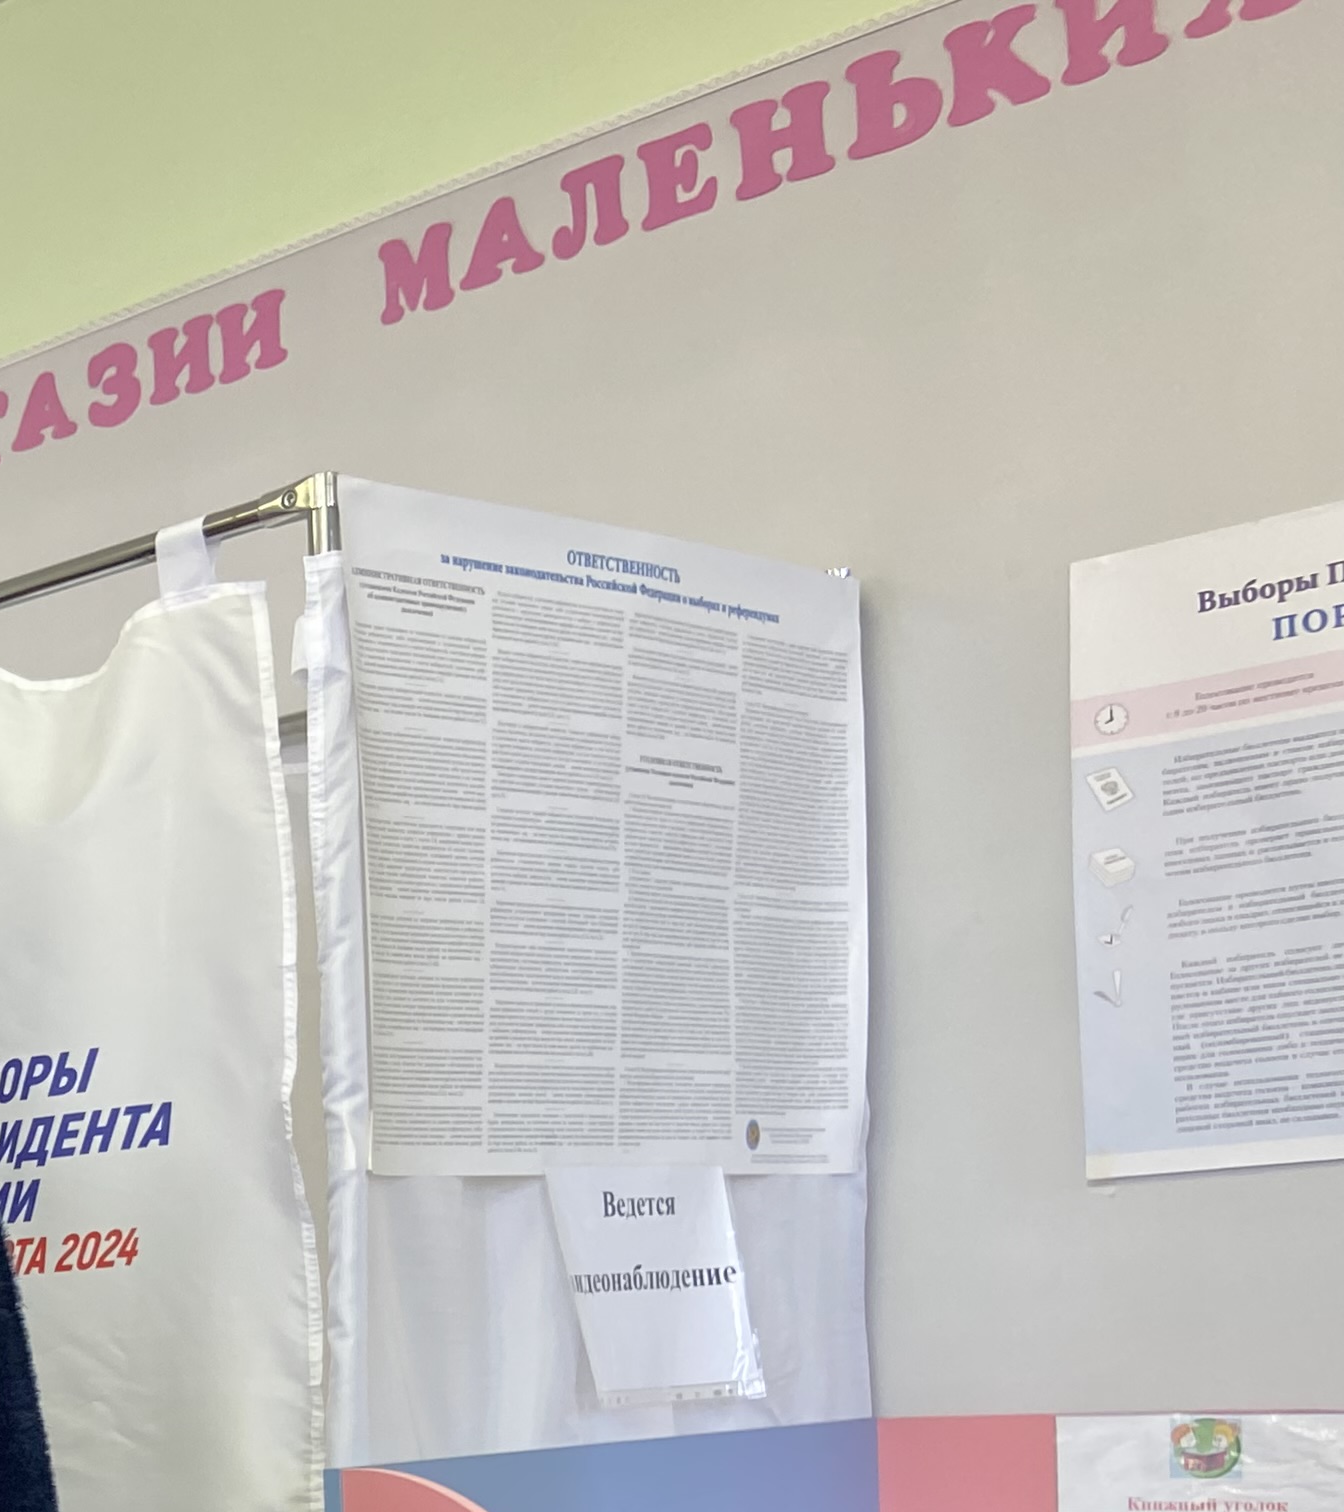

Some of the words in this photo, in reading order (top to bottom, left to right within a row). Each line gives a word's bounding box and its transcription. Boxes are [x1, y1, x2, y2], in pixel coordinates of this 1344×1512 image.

[567, 550, 681, 583] ОТВЕТСТВЕННОСТЬ
[586, 575, 637, 594] Российской
[1197, 573, 1320, 613] Выборы
[602, 1191, 675, 1220] Ведется
[54, 1227, 139, 1273] 2024
[1127, 1496, 1217, 1512] Книжный
